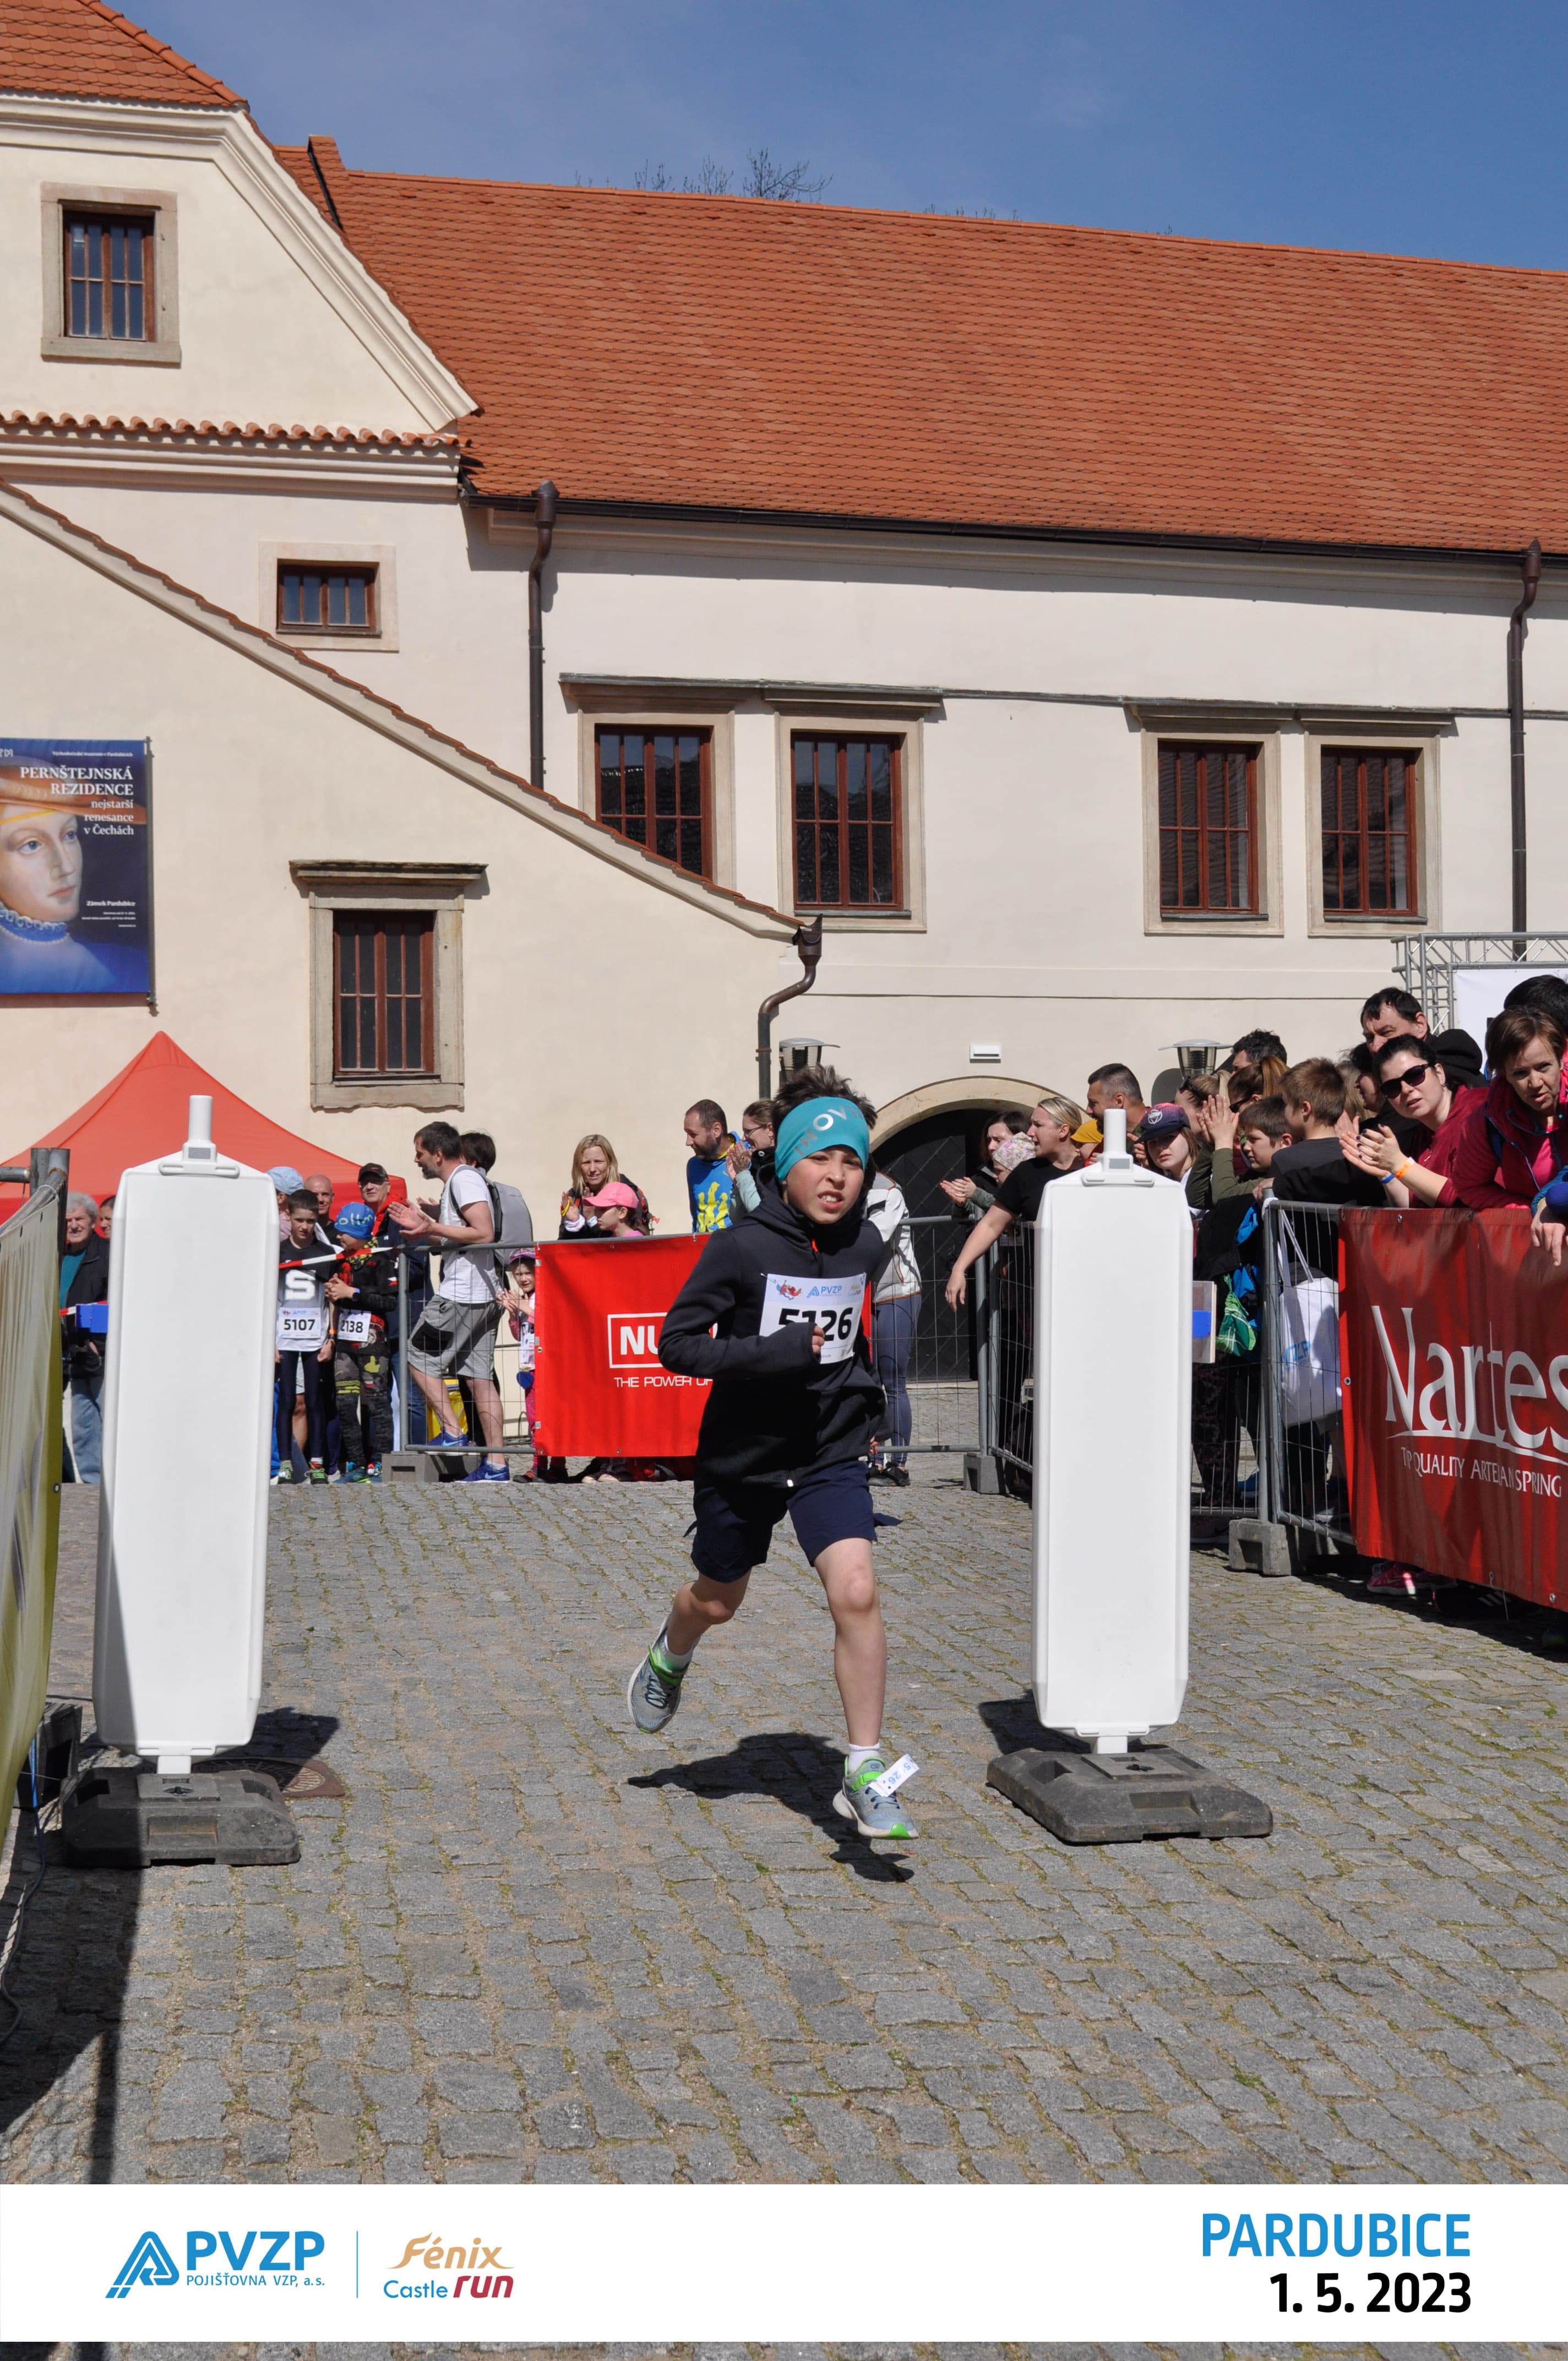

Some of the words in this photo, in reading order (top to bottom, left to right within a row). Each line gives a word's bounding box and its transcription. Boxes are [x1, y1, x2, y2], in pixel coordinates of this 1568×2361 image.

[20, 765, 133, 780] PERNŠTEJNSKÁ
[51, 784, 134, 796] REZIDENCE
[91, 799, 134, 810] nejstarší
[92, 824, 134, 835] Čechách
[820, 1286, 842, 1294] PVZP
[284, 1319, 315, 1331] 5107
[341, 1320, 363, 1333] 2138
[614, 1377, 639, 1388] THE
[644, 1376, 692, 1387] POWER
[1413, 1451, 1465, 1478] QUALITY
[1515, 1469, 1562, 1498] SPRING
